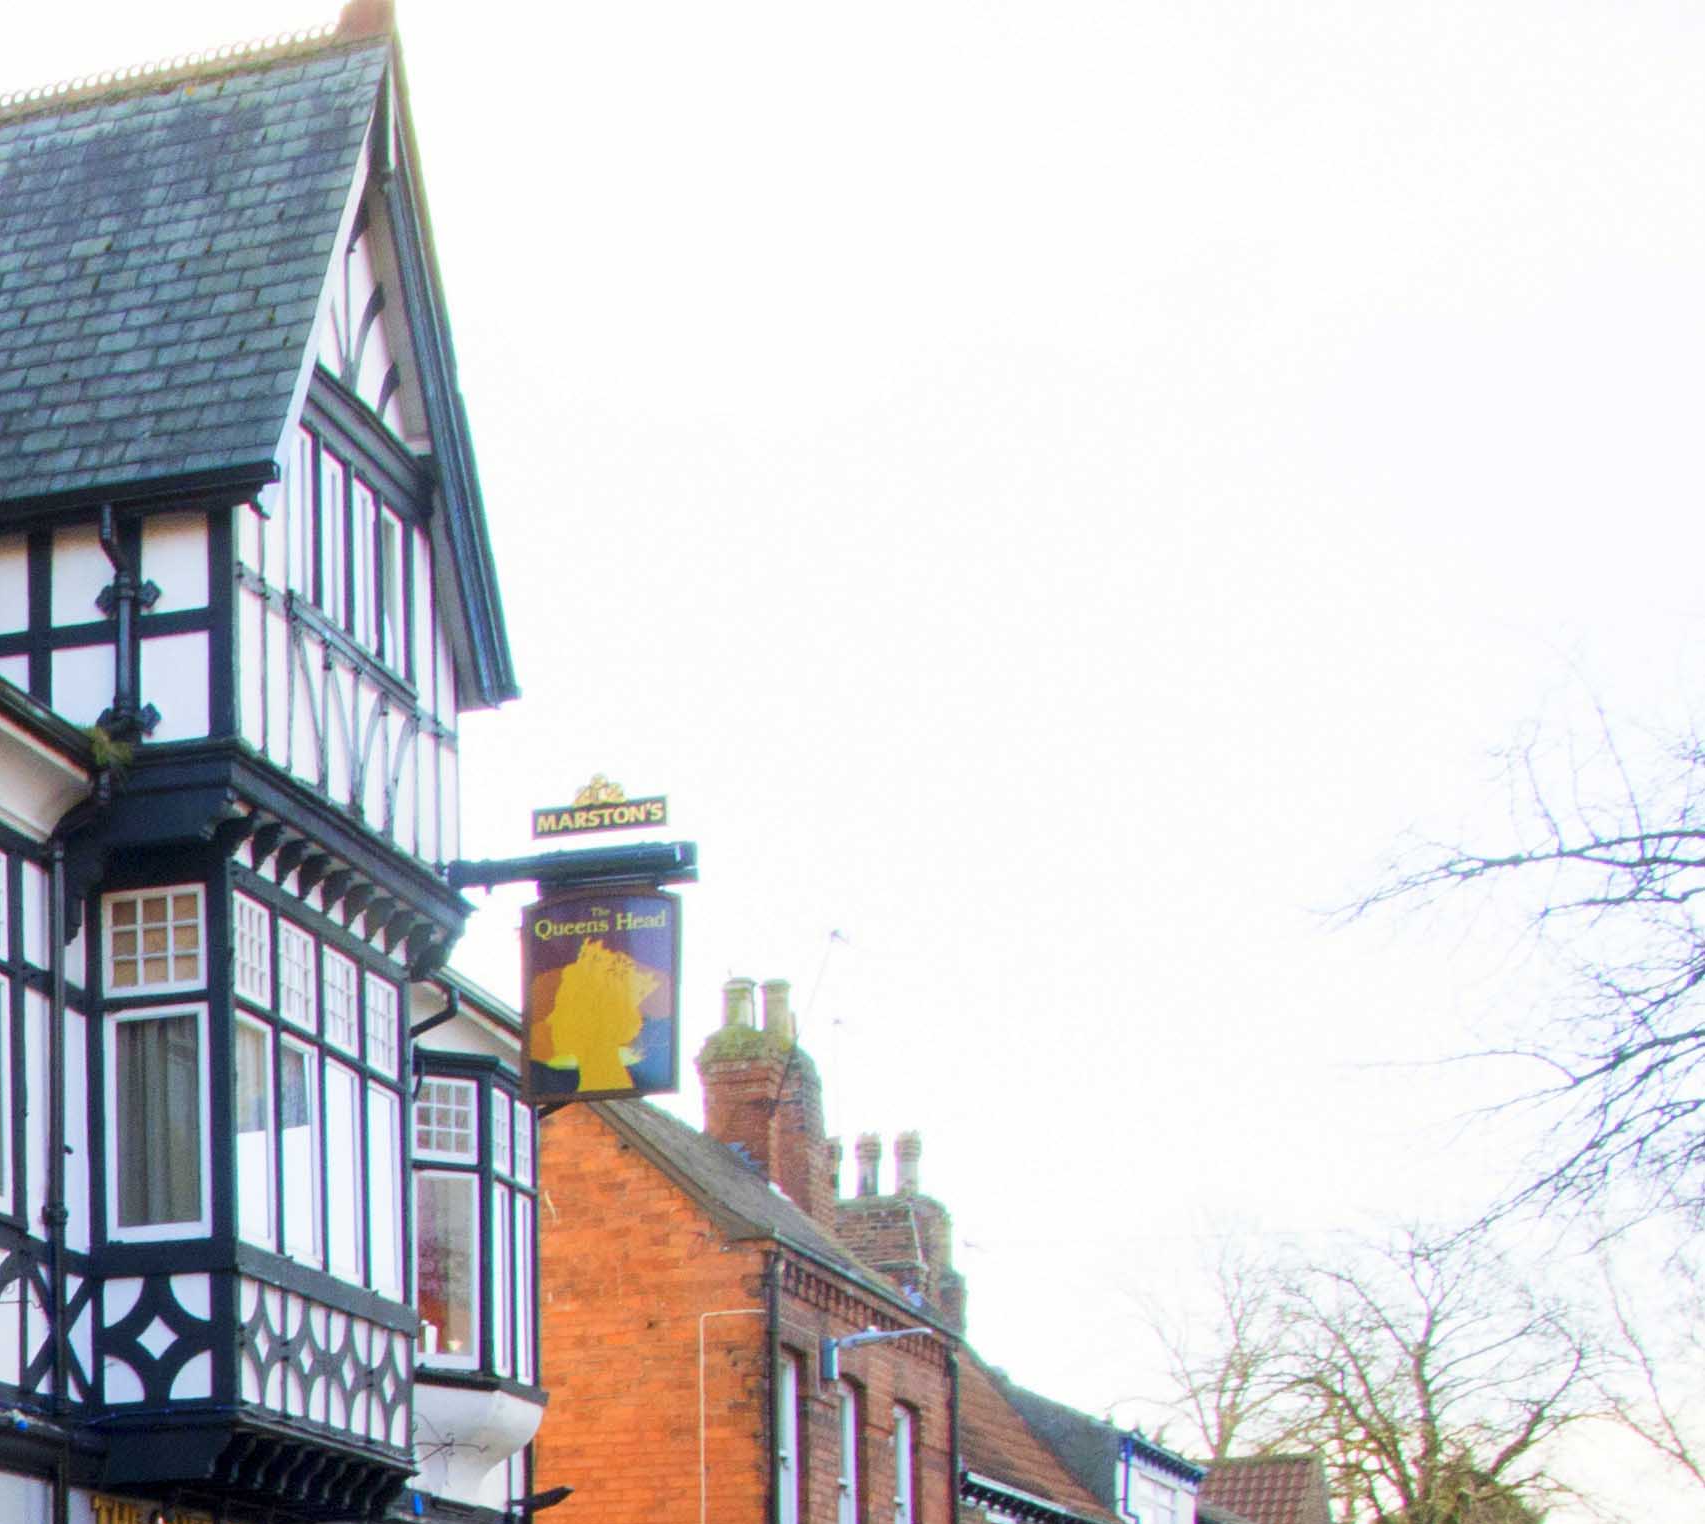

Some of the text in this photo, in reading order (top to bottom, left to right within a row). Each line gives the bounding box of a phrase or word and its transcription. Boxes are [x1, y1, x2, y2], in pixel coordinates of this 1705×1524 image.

[536, 802, 664, 834] MARSTON'S
[534, 908, 667, 940] Queens Head
